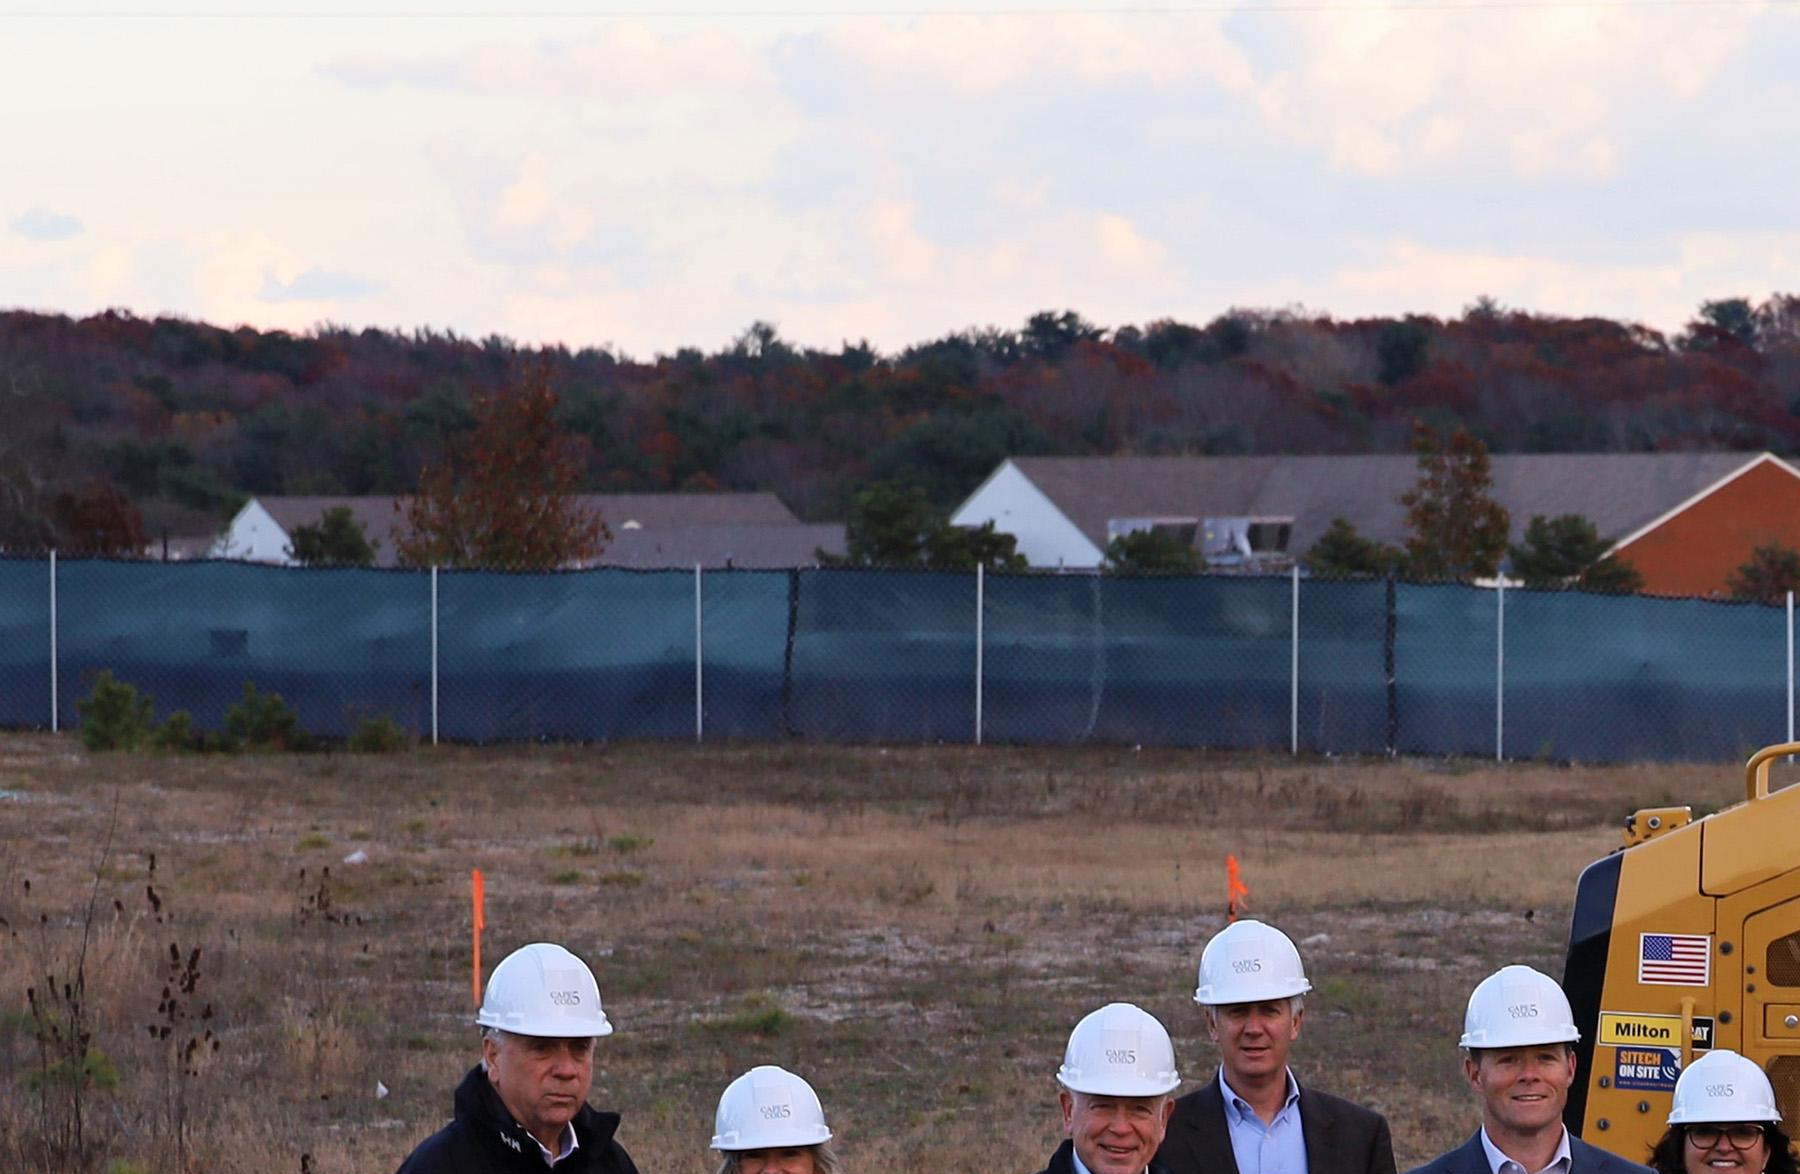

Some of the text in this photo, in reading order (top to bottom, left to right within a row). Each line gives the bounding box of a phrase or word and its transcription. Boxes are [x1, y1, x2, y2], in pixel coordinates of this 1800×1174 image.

[1615, 1022, 1670, 1039] Milton
[1620, 1051, 1662, 1065] SITECH
[1619, 1065, 1660, 1079] ON SITE
